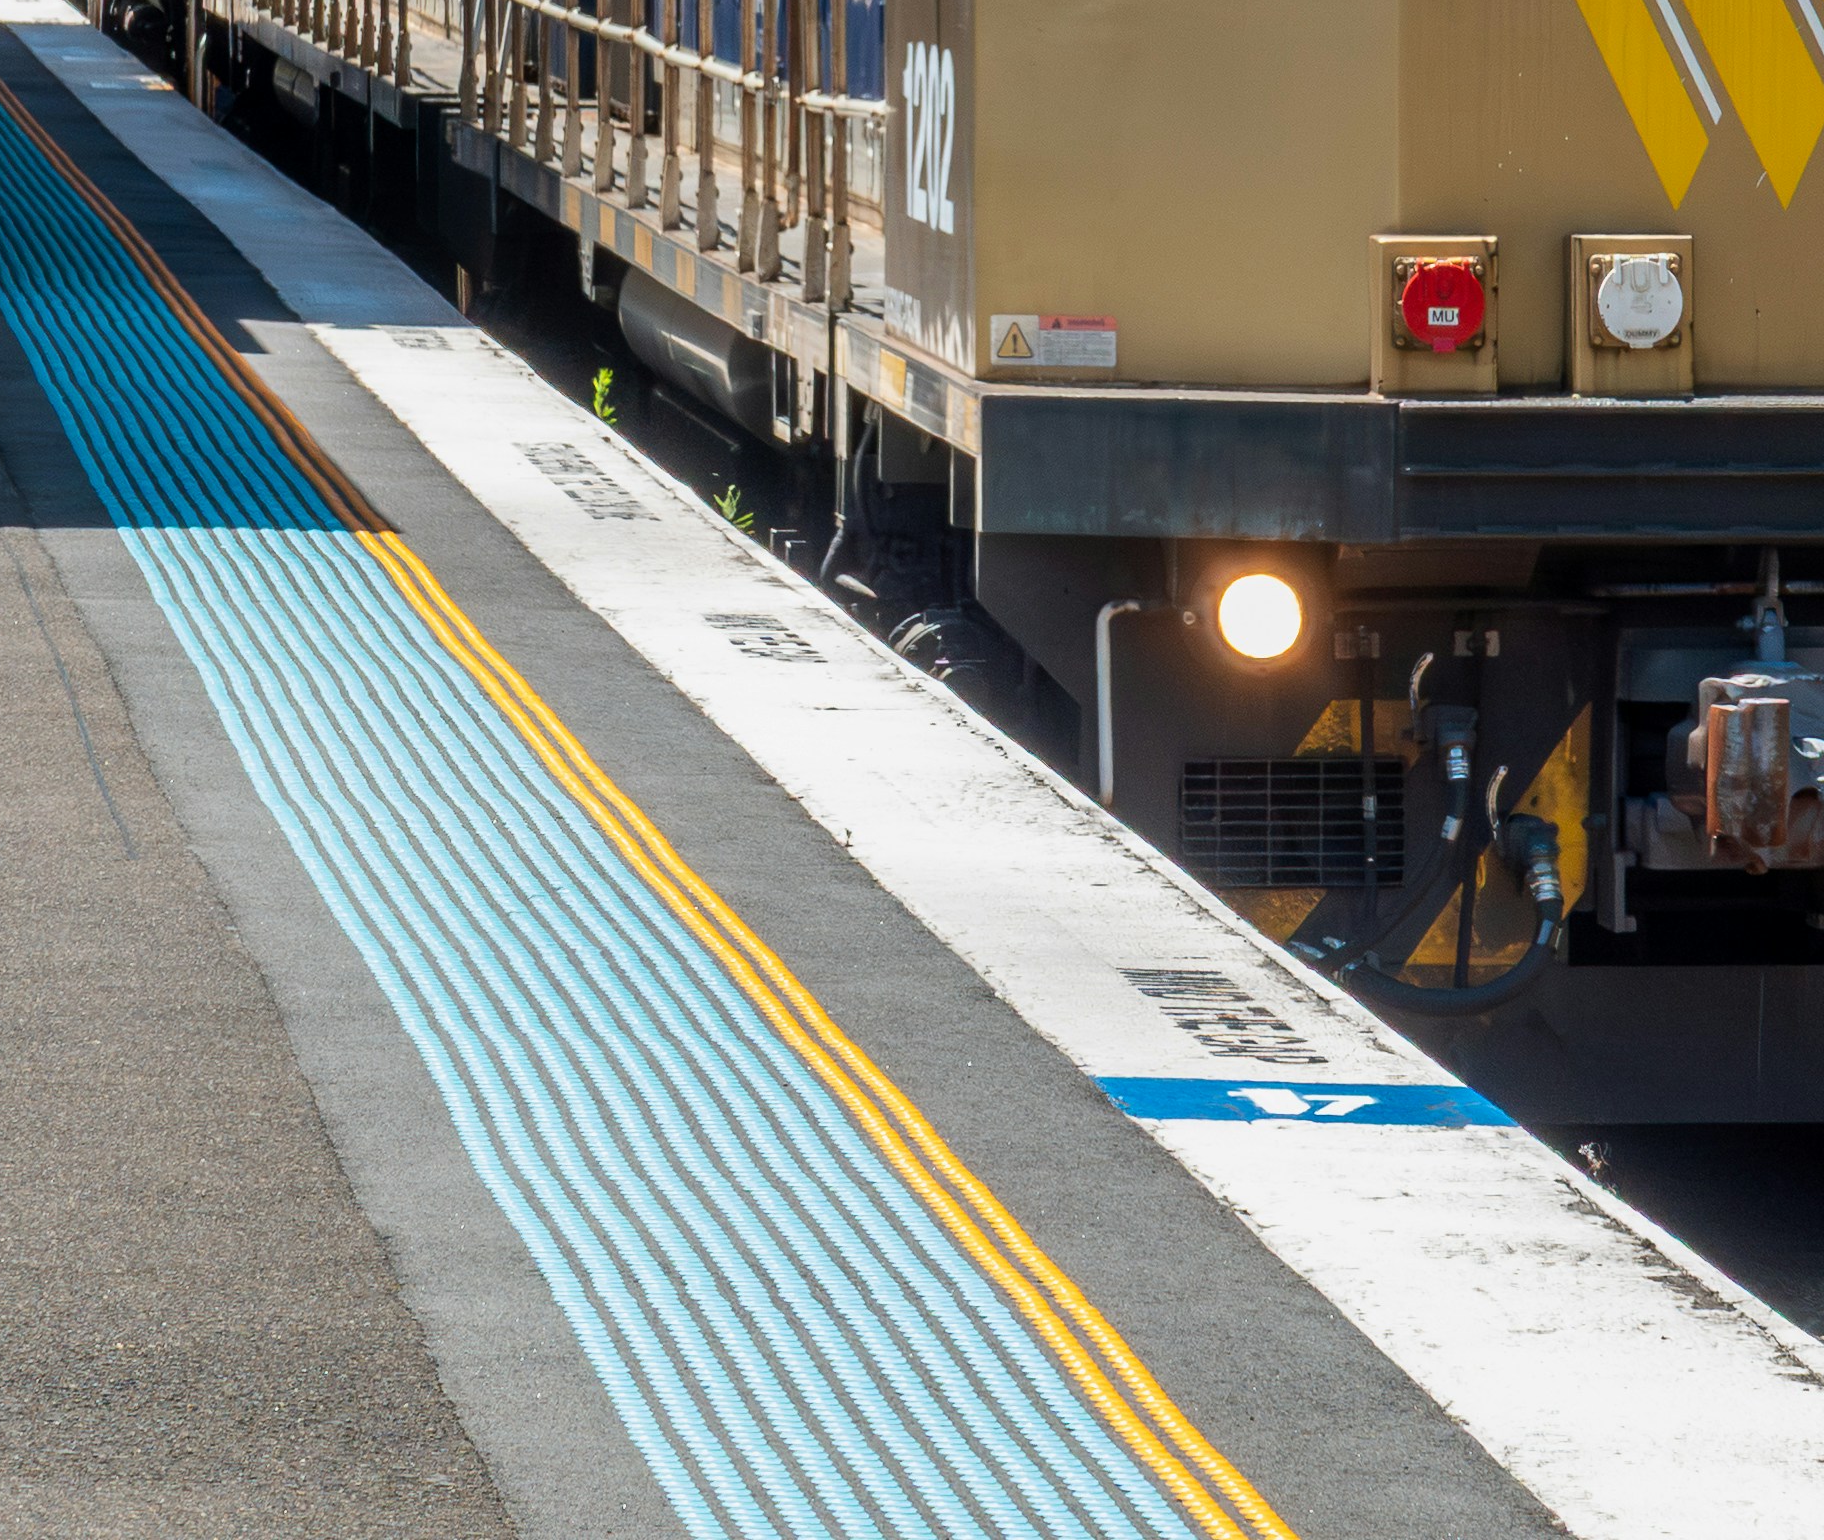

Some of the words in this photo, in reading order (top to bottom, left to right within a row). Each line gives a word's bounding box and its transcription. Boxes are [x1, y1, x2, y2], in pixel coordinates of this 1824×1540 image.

[903, 41, 955, 234] 1202
[1432, 310, 1455, 322] MU
[1159, 1006, 1295, 1031] THE
[1193, 1034, 1329, 1064] GAP
